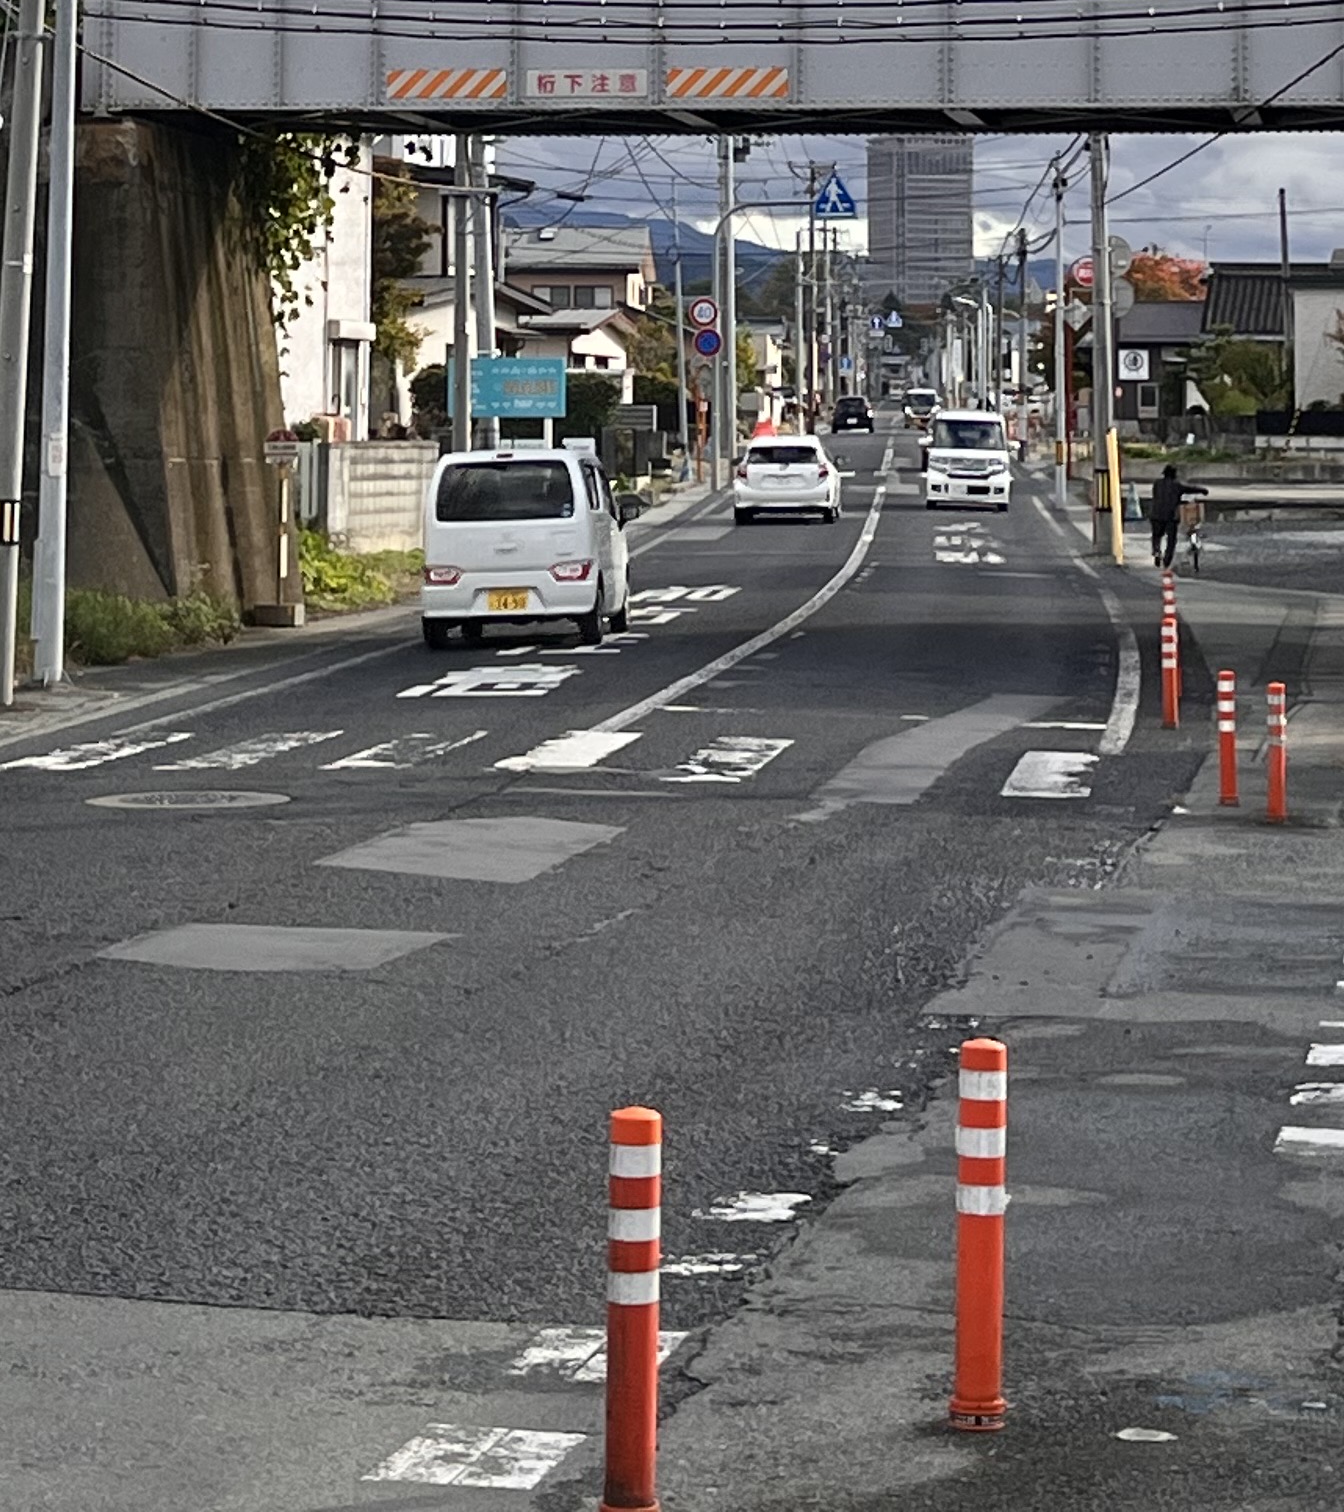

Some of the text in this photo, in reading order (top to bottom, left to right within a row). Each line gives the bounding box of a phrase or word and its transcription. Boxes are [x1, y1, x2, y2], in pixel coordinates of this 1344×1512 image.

[537, 73, 638, 94] 桁下注意
[697, 306, 712, 319] 40
